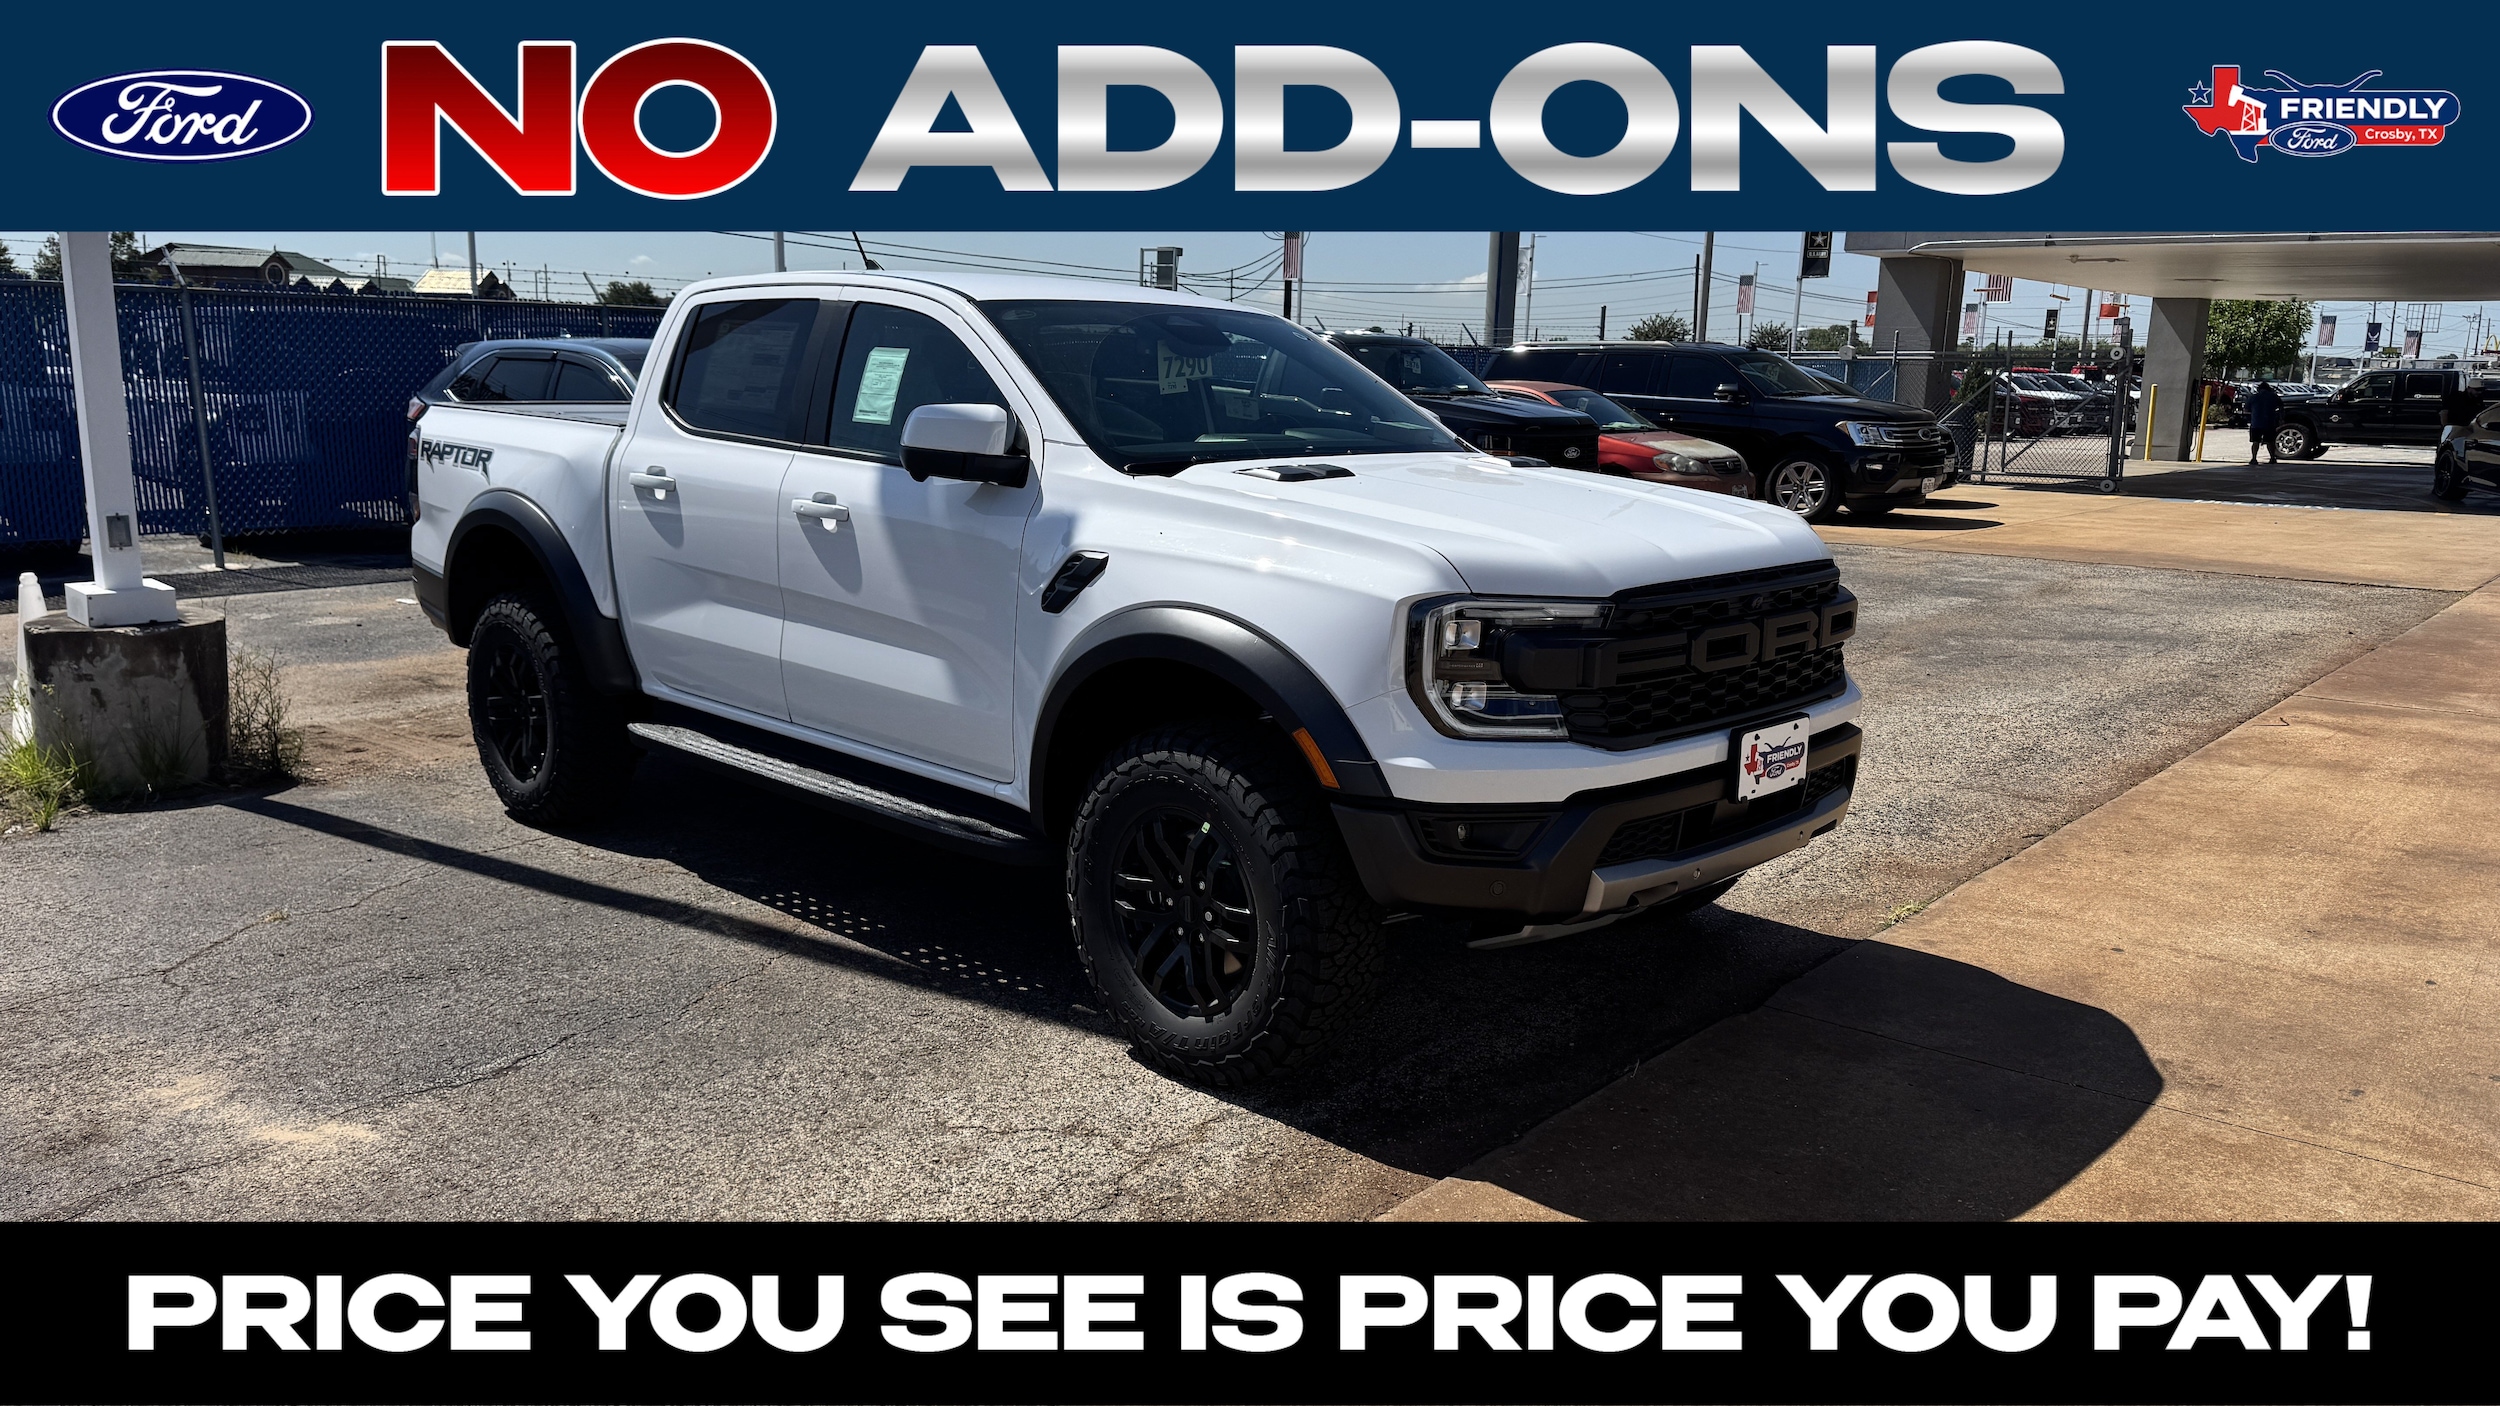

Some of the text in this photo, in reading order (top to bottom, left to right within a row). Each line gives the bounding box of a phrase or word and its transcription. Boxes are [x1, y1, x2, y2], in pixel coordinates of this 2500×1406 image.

[1163, 356, 1208, 379] 7290
[421, 438, 494, 486] RAPTOR
[1600, 599, 1858, 688] FORD
[1767, 745, 1803, 764] FRIENDLY
